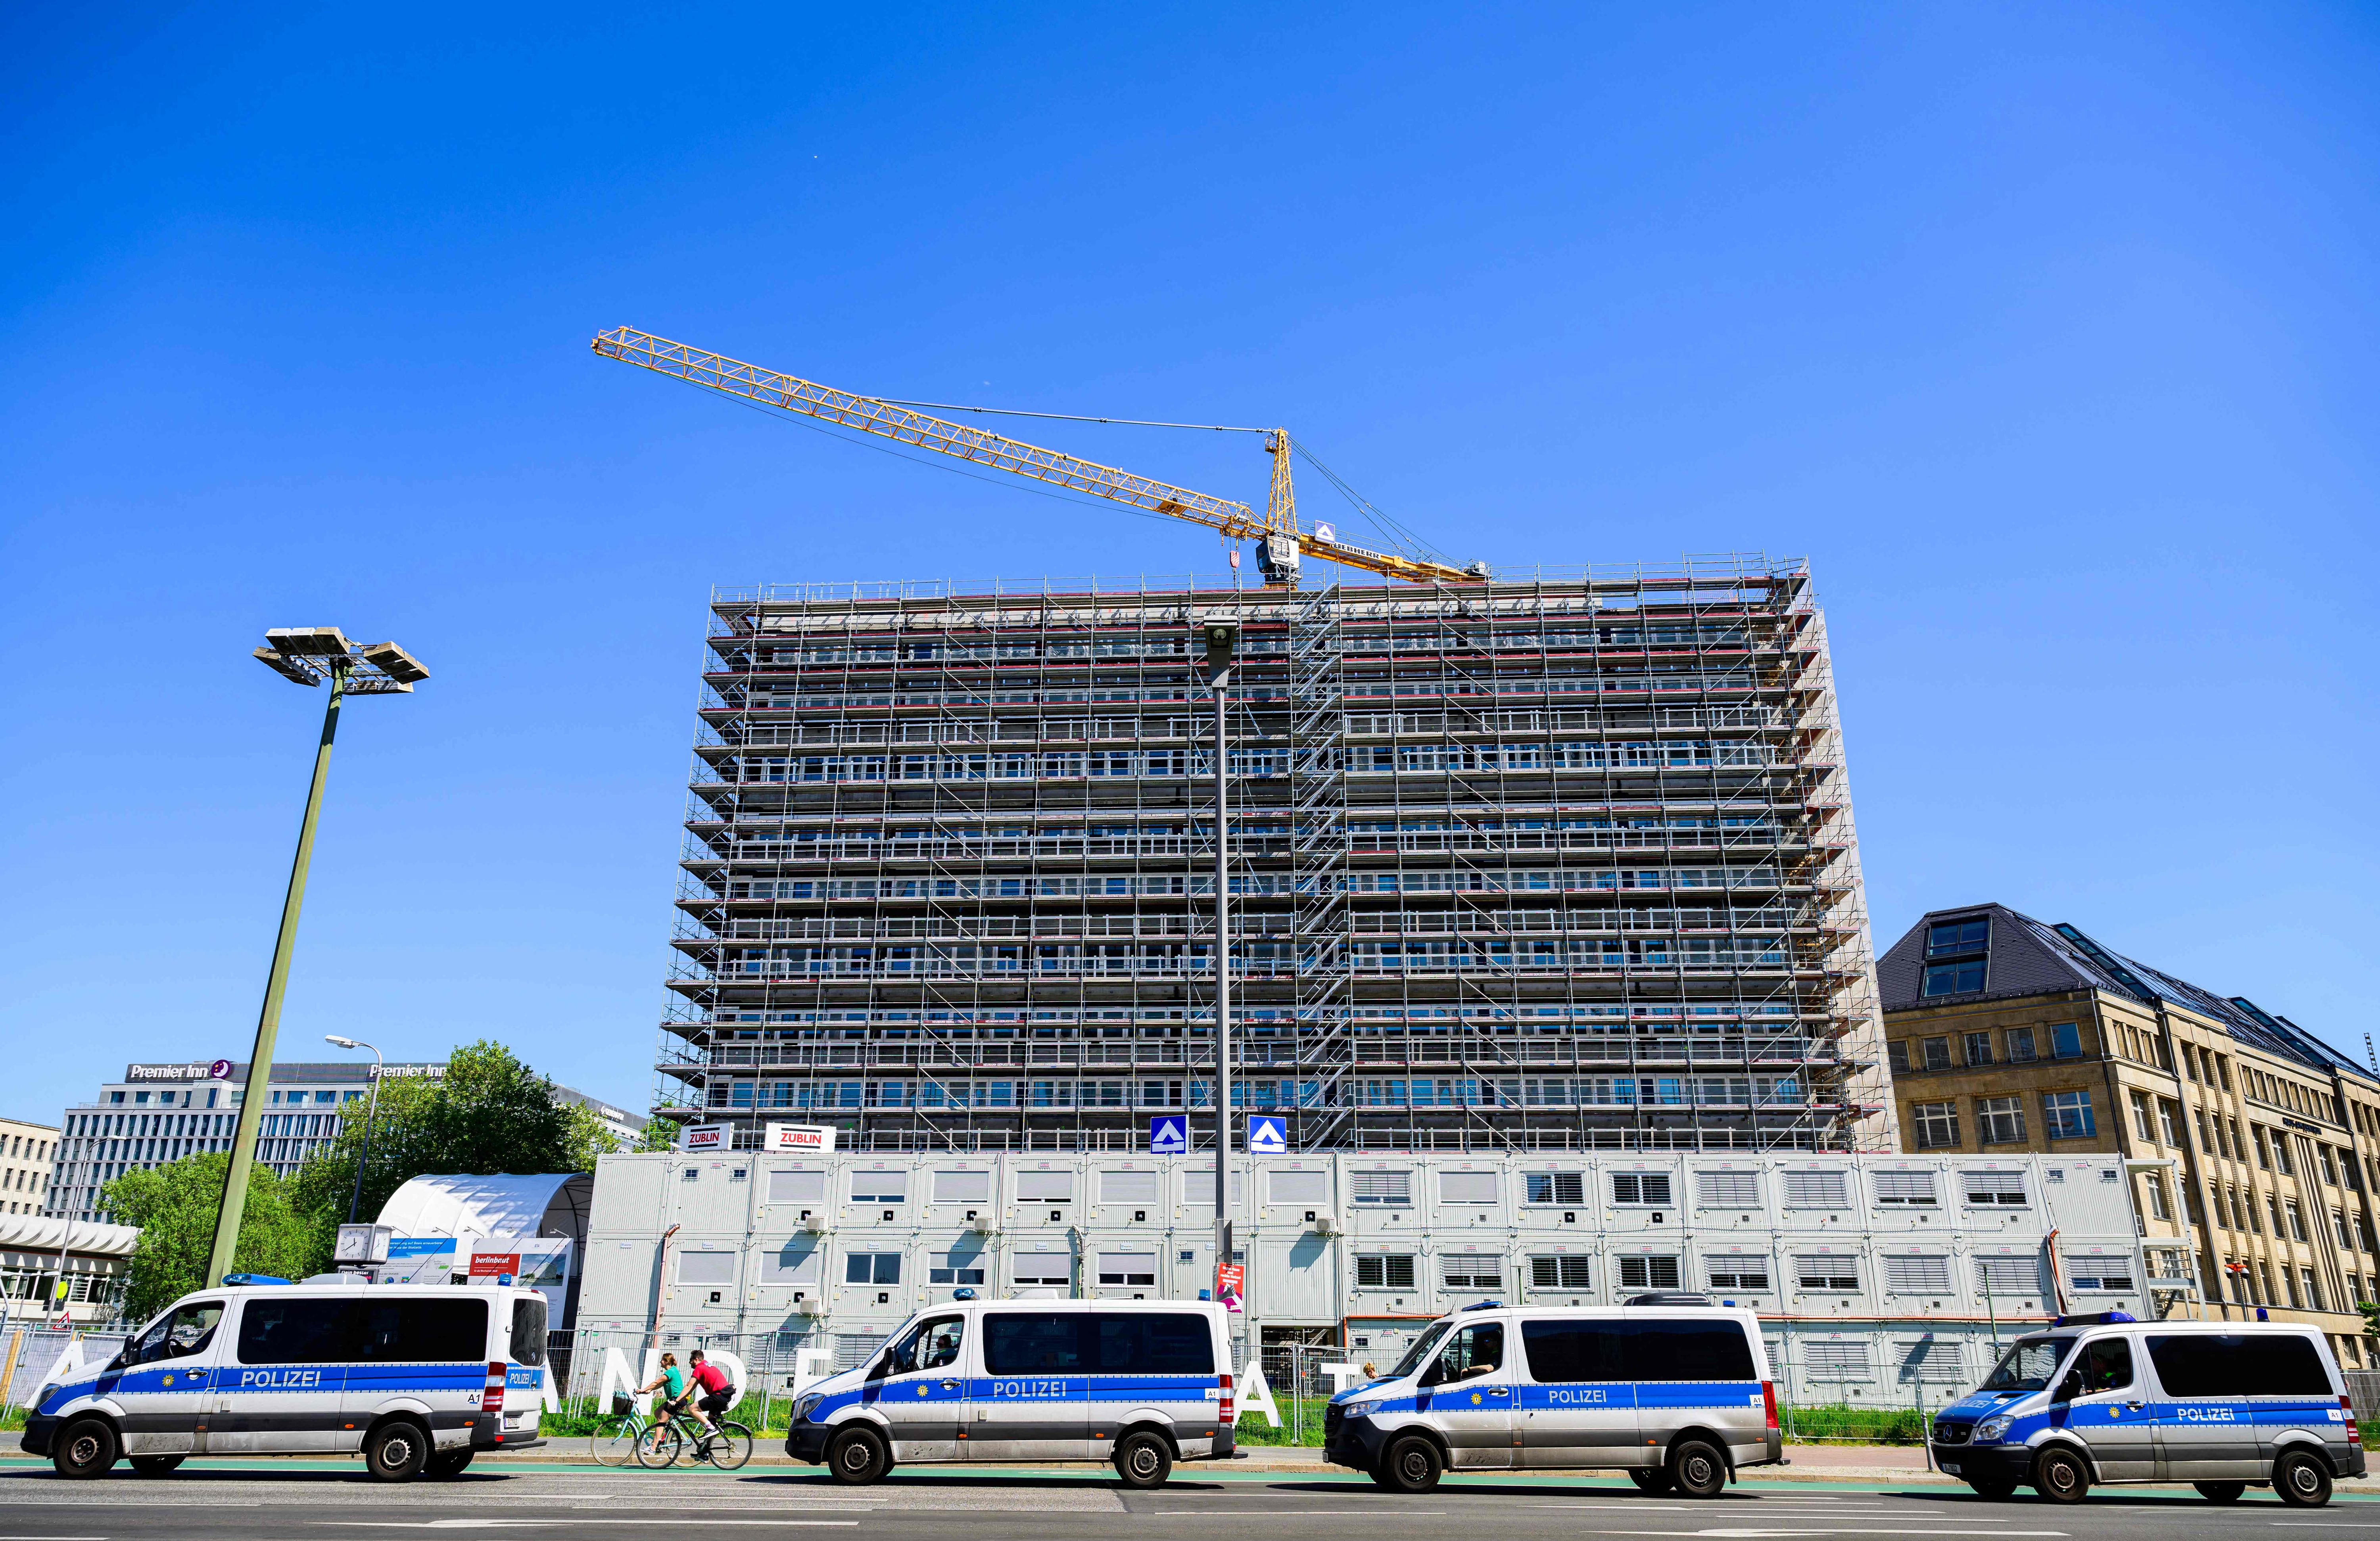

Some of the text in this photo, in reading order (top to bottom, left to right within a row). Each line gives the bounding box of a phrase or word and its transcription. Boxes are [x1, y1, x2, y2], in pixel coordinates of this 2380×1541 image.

[1333, 543, 1379, 559] LIEBHERR
[131, 1065, 208, 1078] Premier Inn
[370, 1064, 425, 1077] Premier
[689, 1132, 719, 1143] ZÜBLIN
[781, 1133, 821, 1144] ZÜBLIN
[241, 1371, 321, 1387] POLIZEI
[509, 1373, 530, 1384] POLIZEI
[994, 1382, 1066, 1397] POLIZEI
[467, 1394, 480, 1402] A1
[1549, 1390, 1606, 1403] POLIZEI
[2177, 1408, 2235, 1421] POLIZEI
